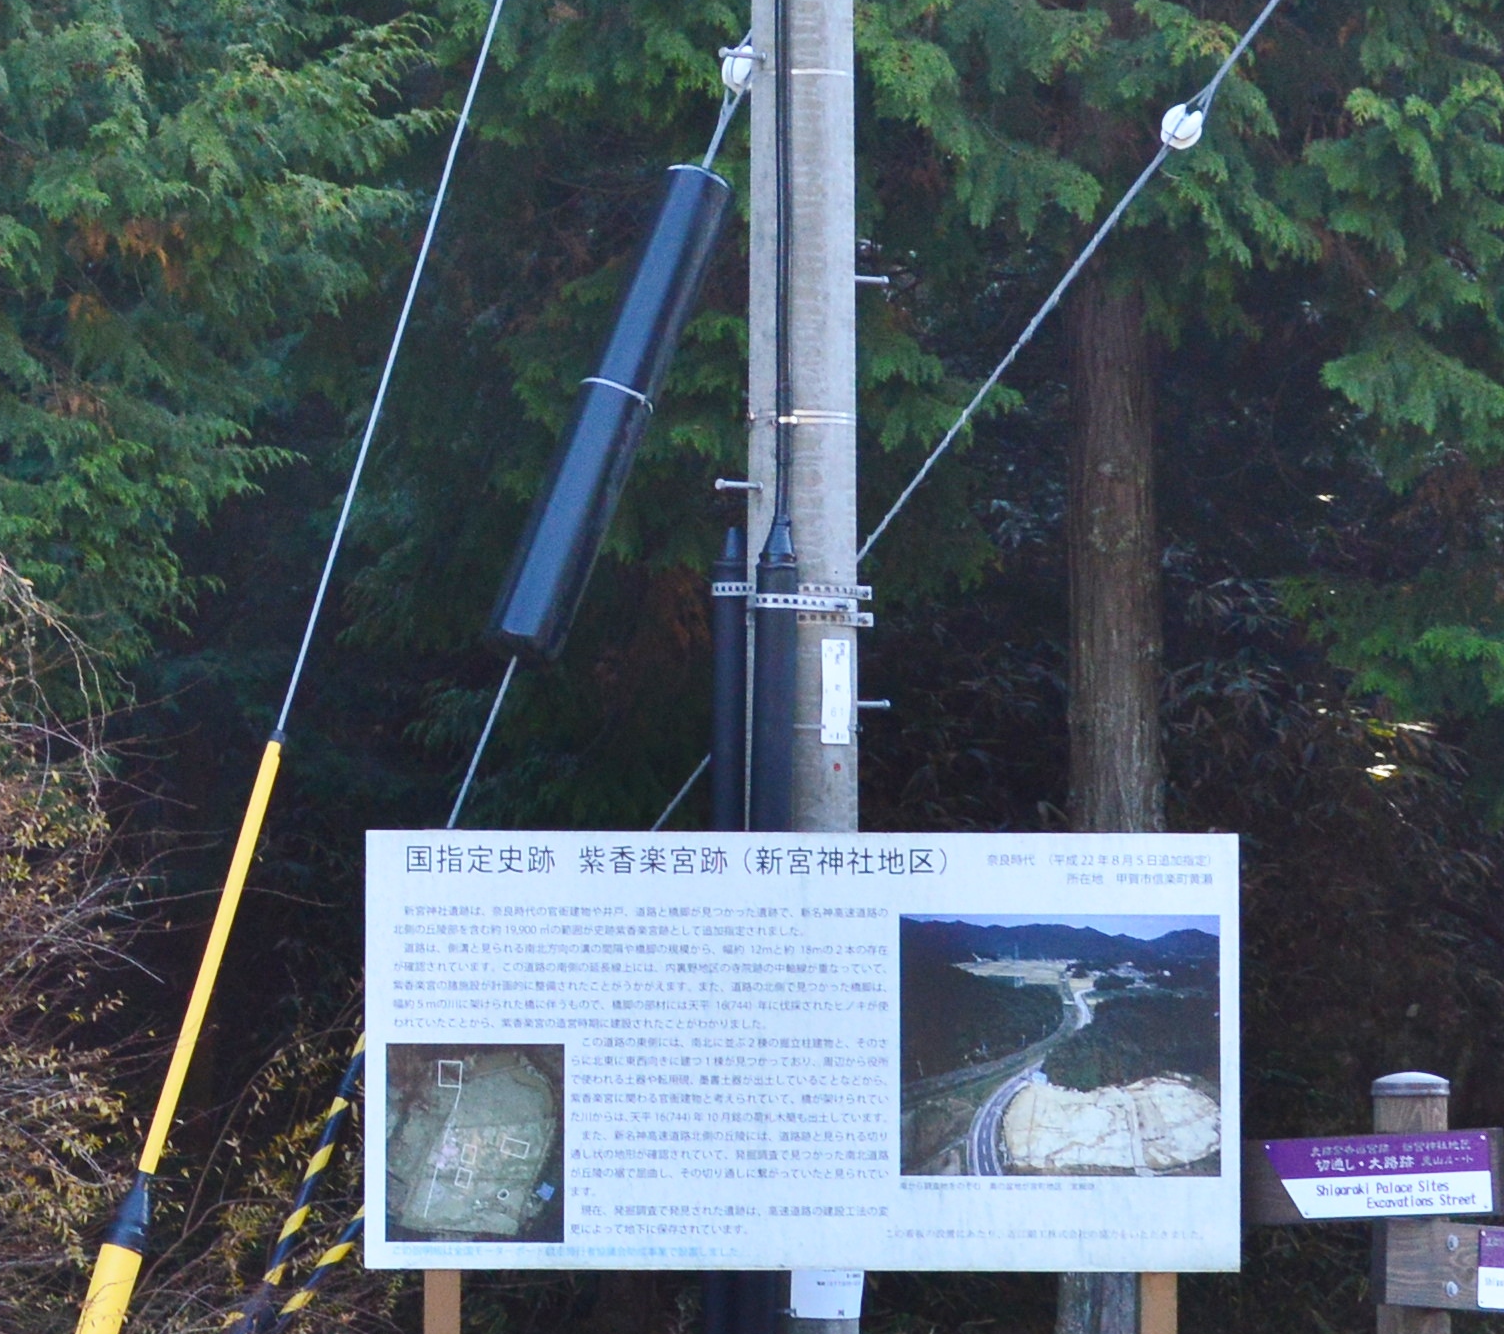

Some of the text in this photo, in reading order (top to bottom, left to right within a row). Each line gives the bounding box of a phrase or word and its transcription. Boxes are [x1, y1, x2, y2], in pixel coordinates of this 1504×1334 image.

[406, 845, 947, 876] 国指定史跡 紫香楽宮跡 （新宮神社地区）
[987, 854, 1035, 867] 奈良時代
[1065, 873, 1104, 886] 所在地
[1316, 1180, 1450, 1197] Shigaraki Palace Sites
[1366, 1192, 1477, 1208] Excavations Street
